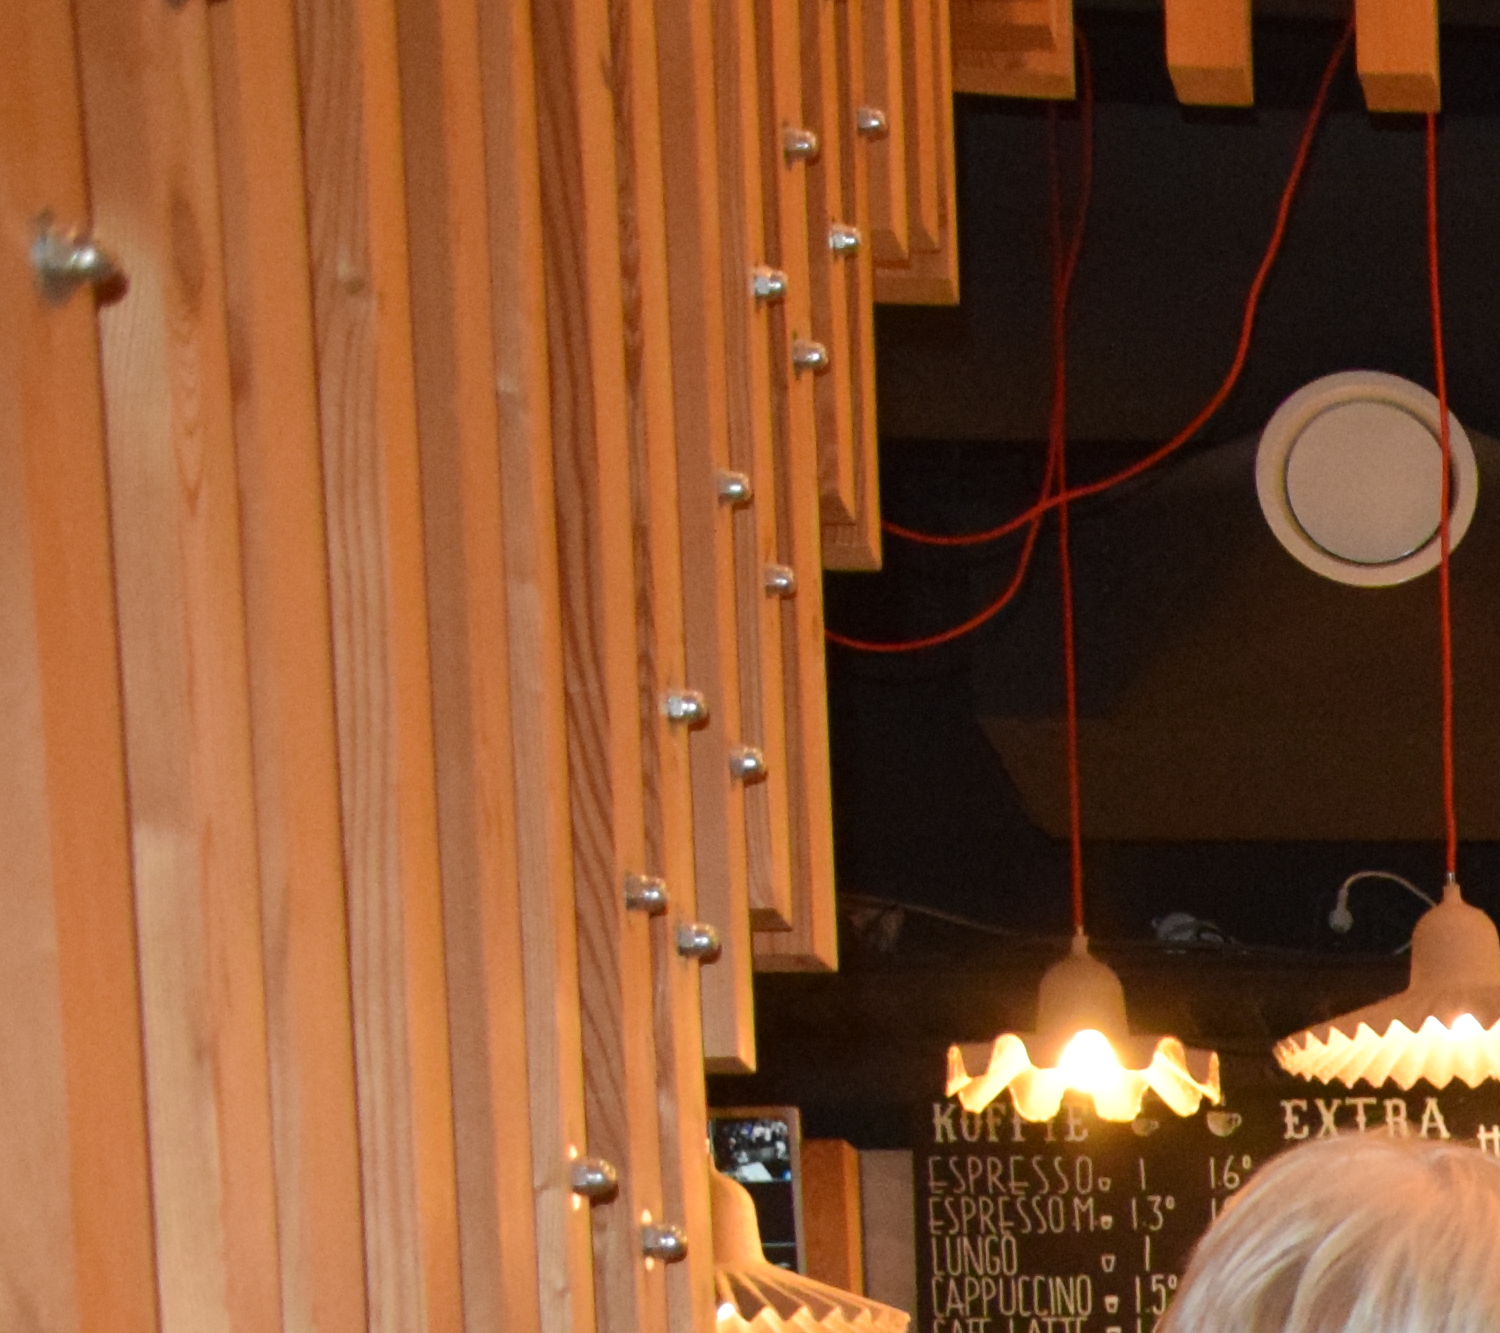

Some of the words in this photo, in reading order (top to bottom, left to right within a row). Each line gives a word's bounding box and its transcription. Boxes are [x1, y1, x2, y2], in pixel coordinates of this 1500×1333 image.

[1281, 1097, 1450, 1140] EXTRA
[928, 1155, 1093, 1195] ESPRESSO
[928, 1195, 1065, 1236] ESPRESSO
[931, 1232, 1018, 1277] LUNGO
[931, 1273, 1093, 1318] CAPPUCCINO
